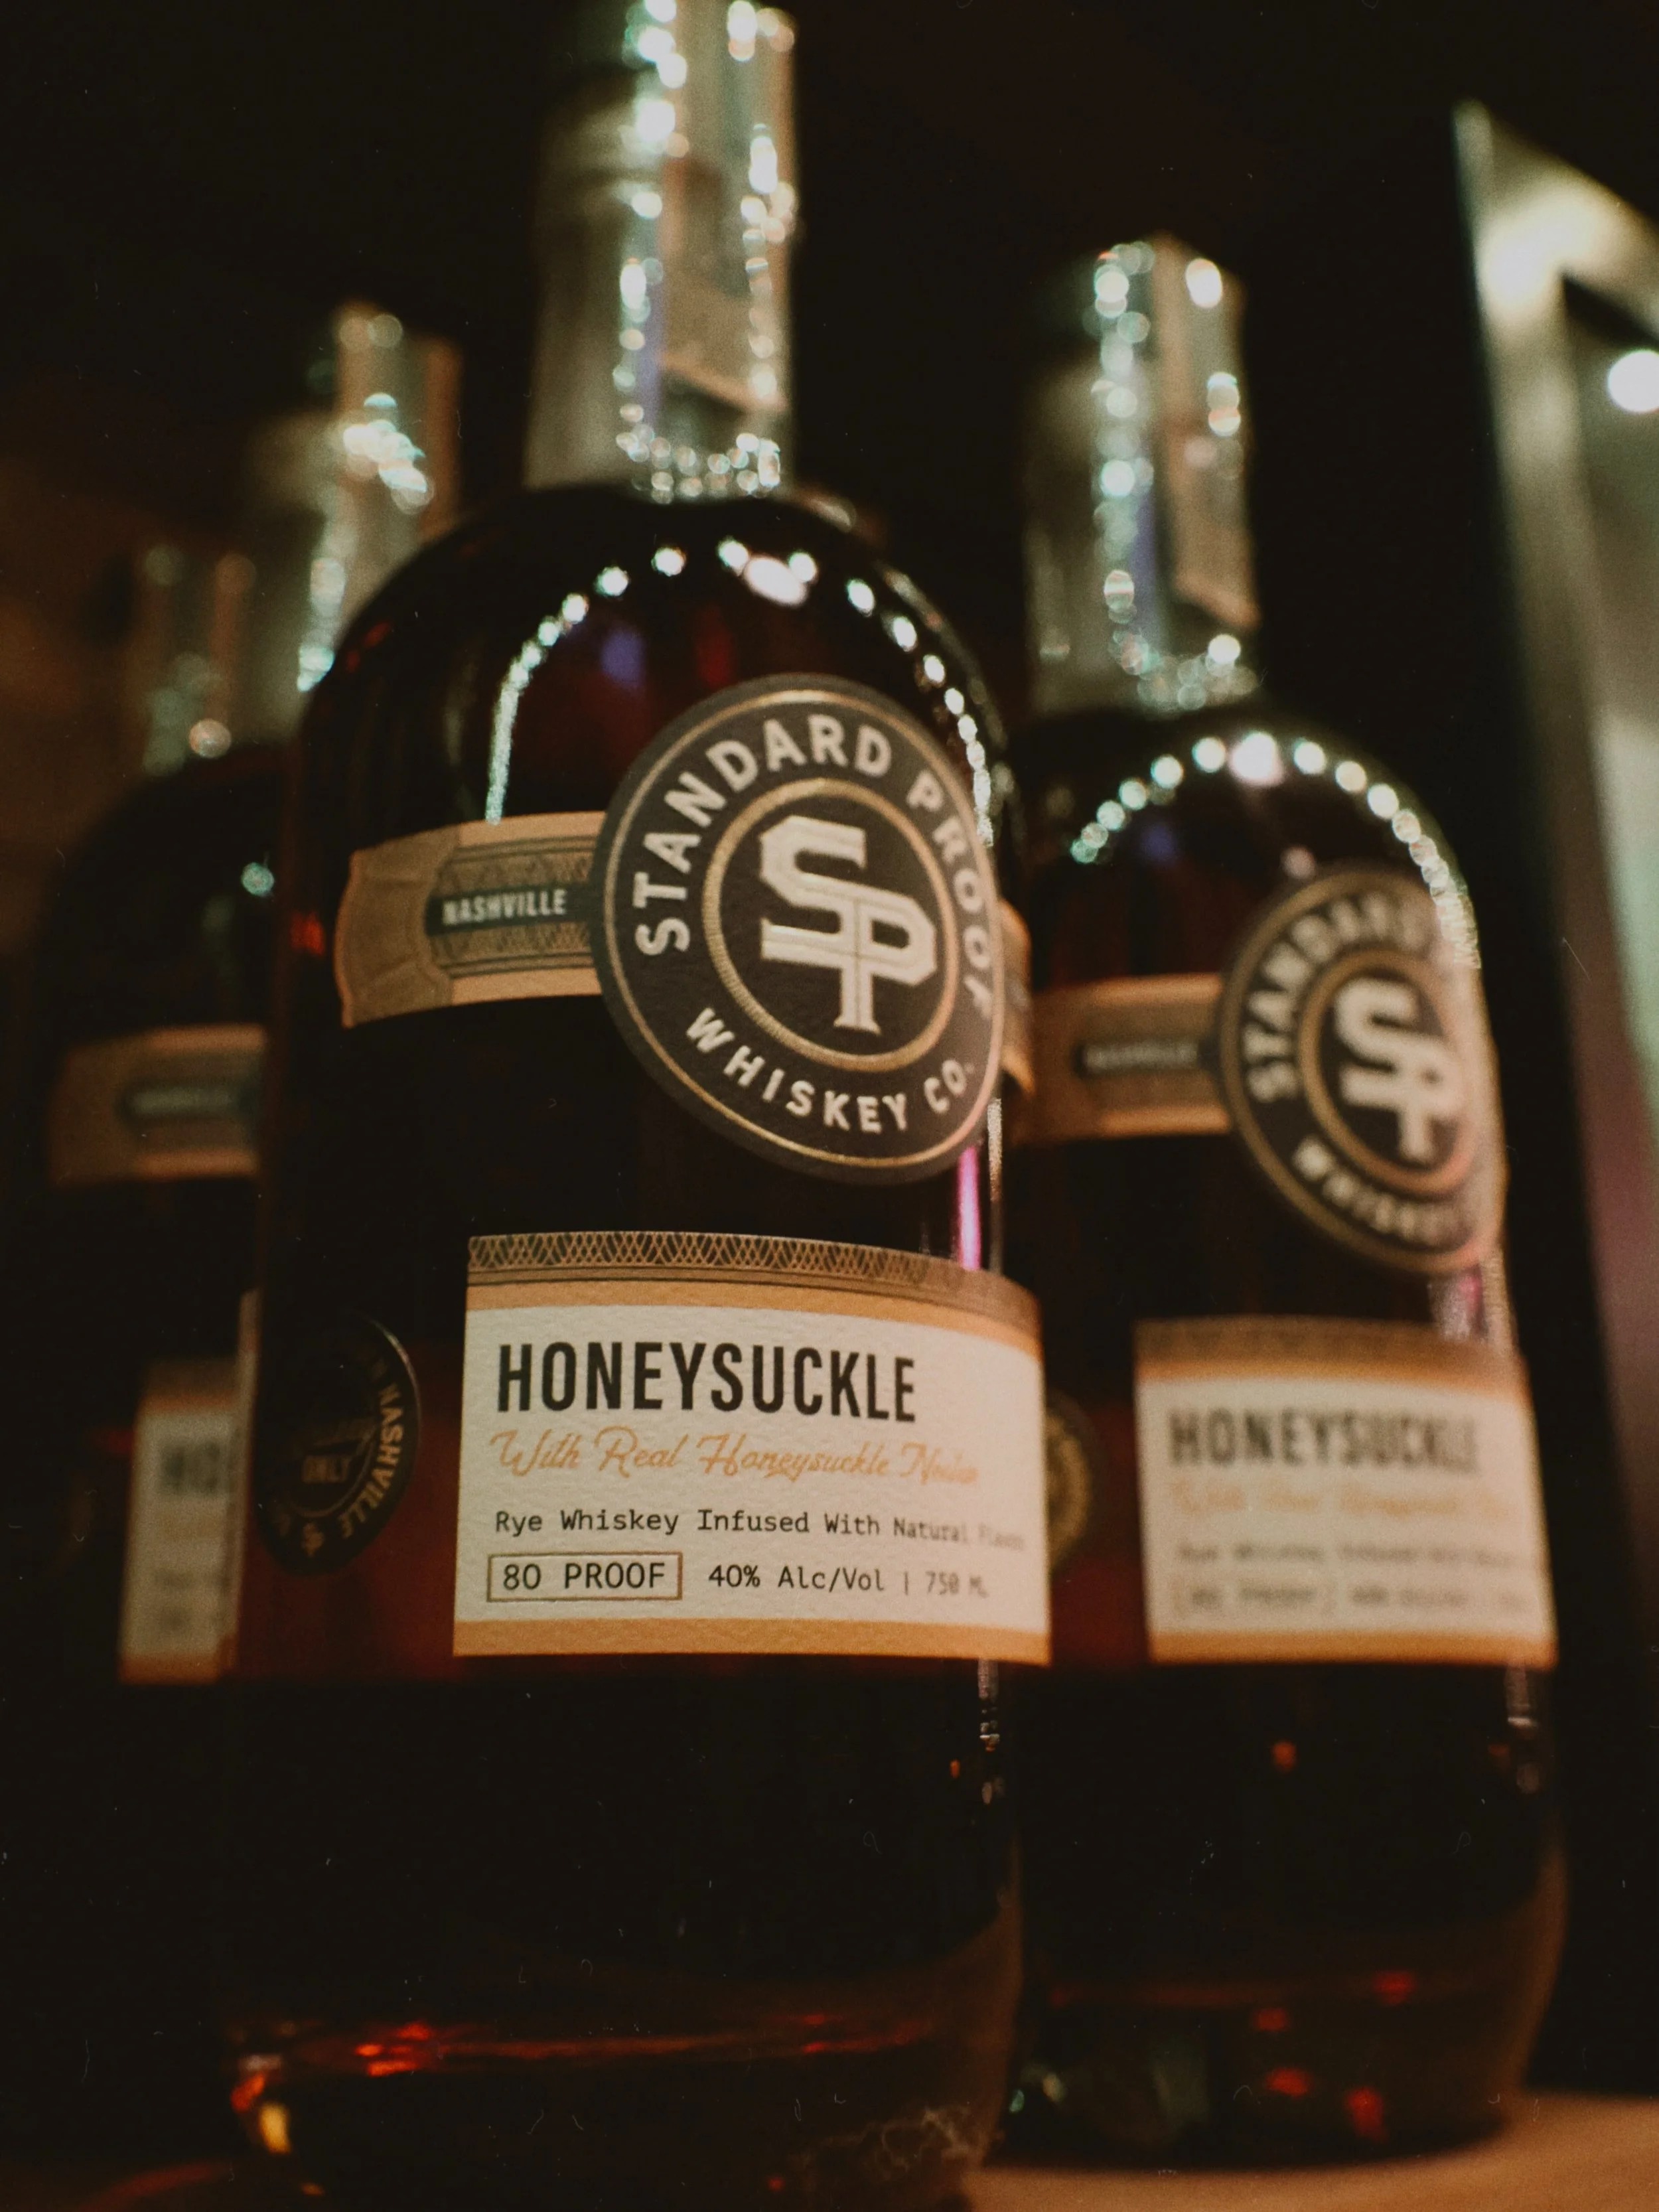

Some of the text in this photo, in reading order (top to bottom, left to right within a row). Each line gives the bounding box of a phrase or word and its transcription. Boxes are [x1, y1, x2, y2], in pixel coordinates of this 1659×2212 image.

[634, 713, 893, 957] STANDARD
[442, 888, 568, 927] NASHVILLE
[685, 1007, 907, 1134] WHISKEY
[496, 1341, 916, 1424] HONEYSUCKLE
[488, 1428, 583, 1478] With
[593, 1424, 689, 1479] Real
[695, 1432, 891, 1483] Honeysuckle
[495, 1510, 543, 1538] Rye
[559, 1509, 680, 1536] Whiskey
[697, 1509, 810, 1534] Infused
[824, 1512, 880, 1536] With
[893, 1516, 969, 1544] Natural
[502, 1562, 666, 1591] 80 PROOF
[707, 1564, 761, 1588] 40%
[777, 1565, 885, 1593] Alc/Vol
[925, 1570, 960, 1596] 750
